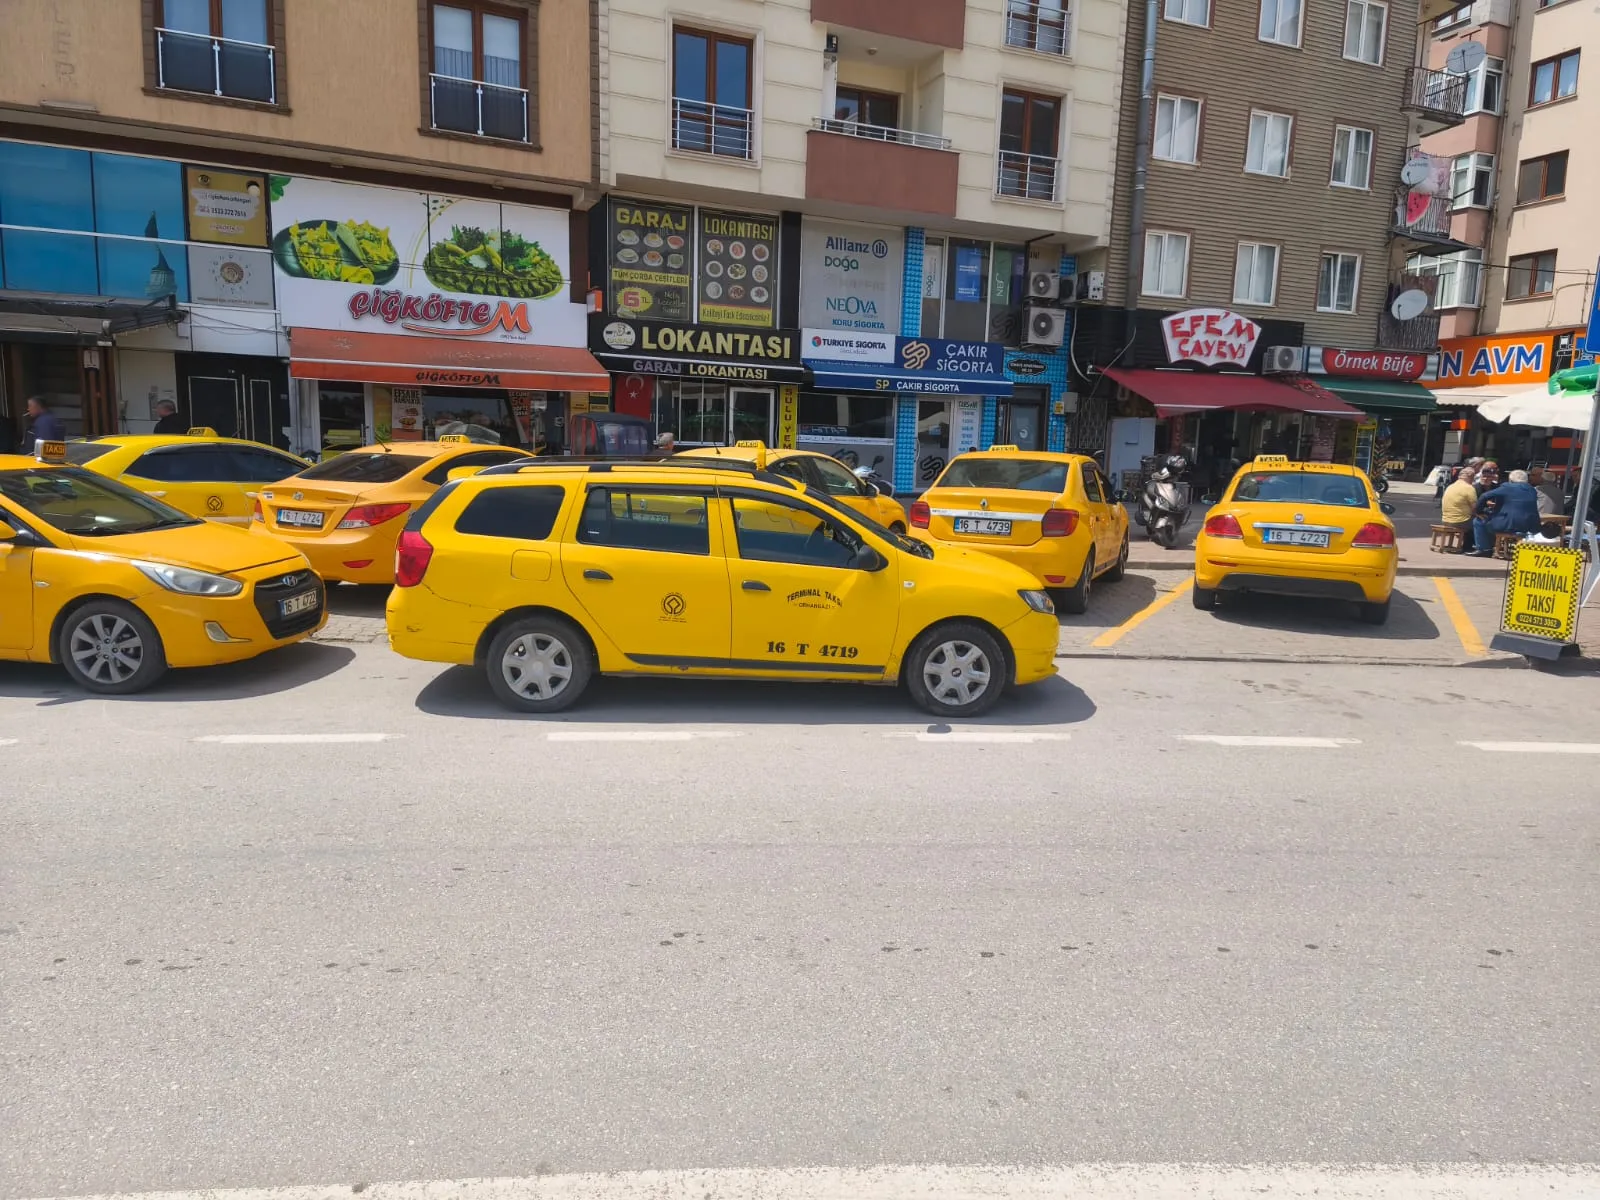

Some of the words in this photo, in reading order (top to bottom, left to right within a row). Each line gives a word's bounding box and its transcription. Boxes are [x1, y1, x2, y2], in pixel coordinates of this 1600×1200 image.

[616, 207, 687, 231] GARAJ
[704, 217, 773, 241] LOKANTASI
[825, 236, 870, 254] Allianz
[824, 255, 859, 271] Doğa
[826, 296, 877, 314] NEOVA
[832, 318, 852, 327] KORU
[642, 326, 791, 359] LOKANTASI
[945, 343, 988, 359] ÇAKIR
[936, 359, 994, 374] SİGORTA
[1334, 349, 1380, 370] Örnek
[1382, 356, 1415, 376] Büfe
[1468, 343, 1544, 376] AVM
[632, 359, 682, 374] GARAJ
[689, 363, 768, 380] LOKANTASI
[876, 379, 890, 390] SP
[896, 381, 923, 392] ÇAKIR
[925, 383, 960, 393] SİGORTA
[282, 511, 290, 520] 16
[295, 512, 299, 521] T
[959, 520, 969, 530] 16
[974, 521, 981, 530] T
[986, 521, 1010, 532] 4739
[1271, 531, 1282, 540] 16
[1289, 532, 1295, 541] T
[1300, 532, 1327, 543] 4723
[1534, 555, 1559, 569] 7/24
[1518, 570, 1568, 593] TERMİNAL
[285, 600, 293, 613] 16
[295, 598, 300, 609] T
[1526, 593, 1556, 614] TAKSİ
[767, 640, 786, 654] 16
[796, 643, 810, 655] T
[818, 644, 859, 659] 4719
